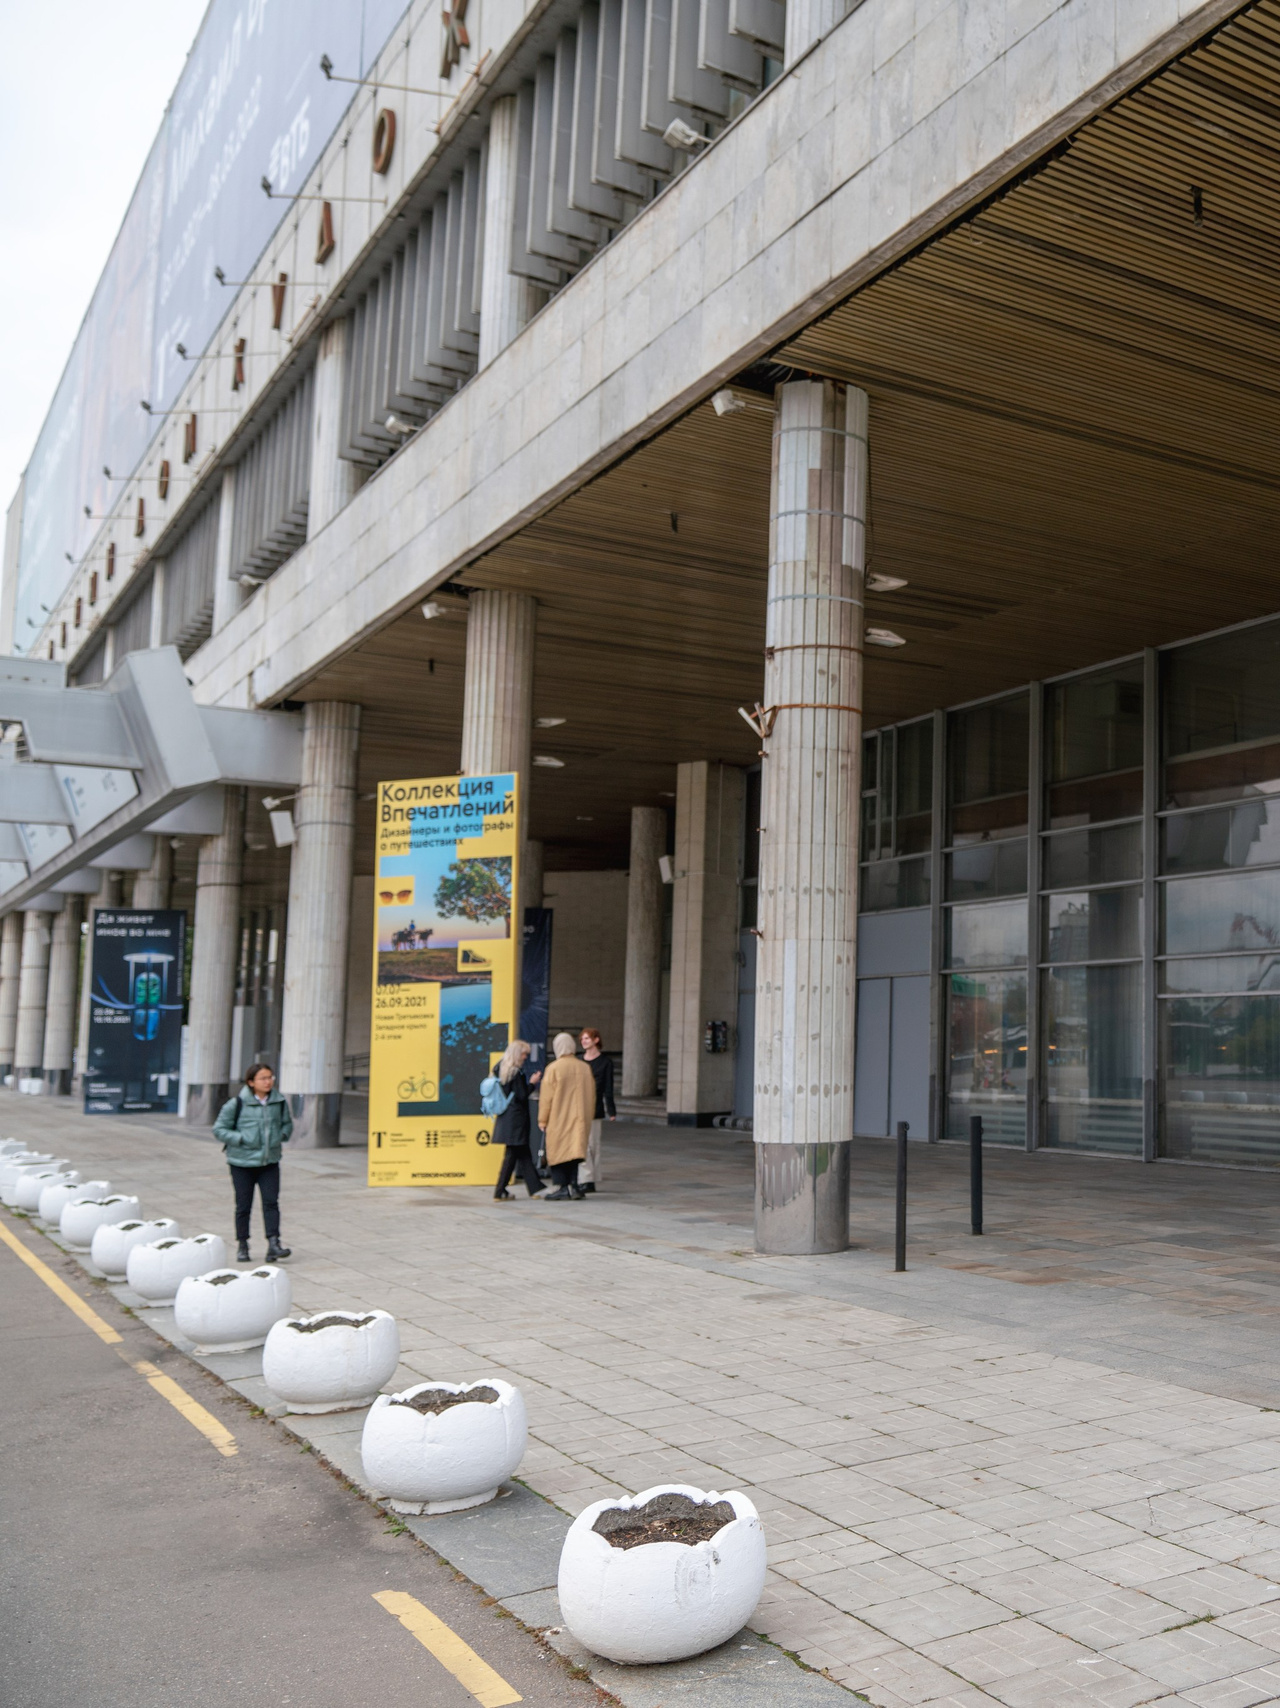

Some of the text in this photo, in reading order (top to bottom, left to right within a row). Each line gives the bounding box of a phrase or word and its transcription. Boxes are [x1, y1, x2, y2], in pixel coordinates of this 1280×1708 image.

[382, 781, 494, 802] Коллекция
[382, 795, 514, 823] Впечатлений
[380, 826, 440, 838] Дизайнеры
[453, 821, 514, 834] фотографы
[390, 838, 463, 851] путешествиях
[375, 996, 427, 1009] 26.09.2021
